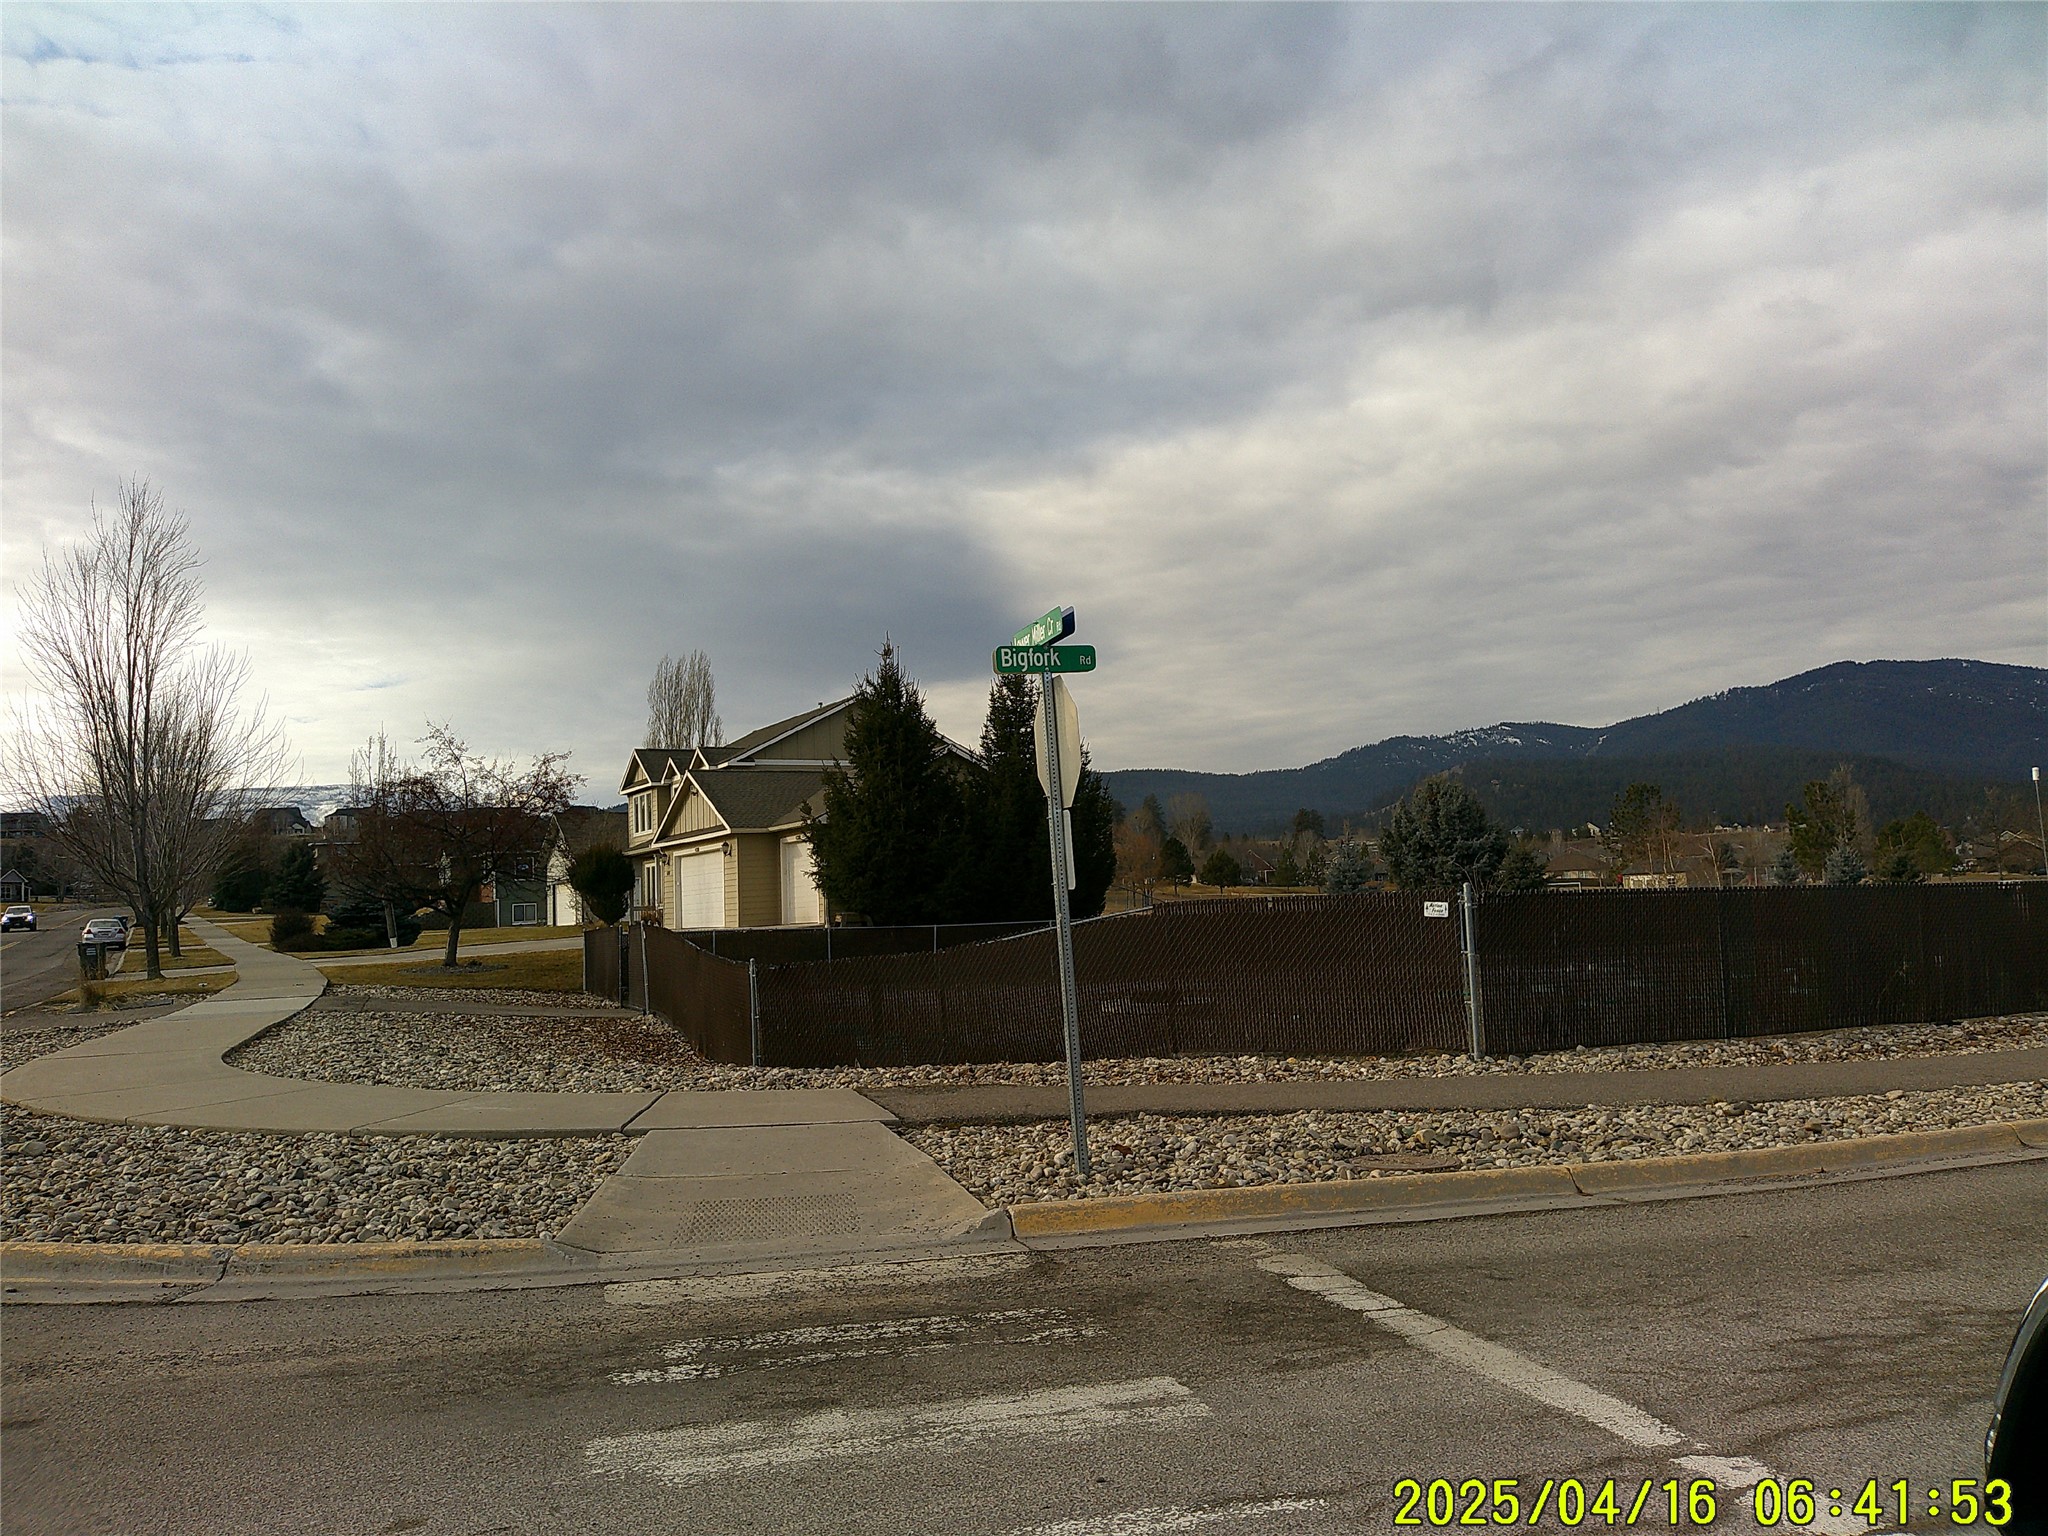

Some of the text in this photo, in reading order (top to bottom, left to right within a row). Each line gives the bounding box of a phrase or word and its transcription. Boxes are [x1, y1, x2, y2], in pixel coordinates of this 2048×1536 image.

[1046, 616, 1054, 636] Cr
[1001, 648, 1092, 672] Bigfork Rd
